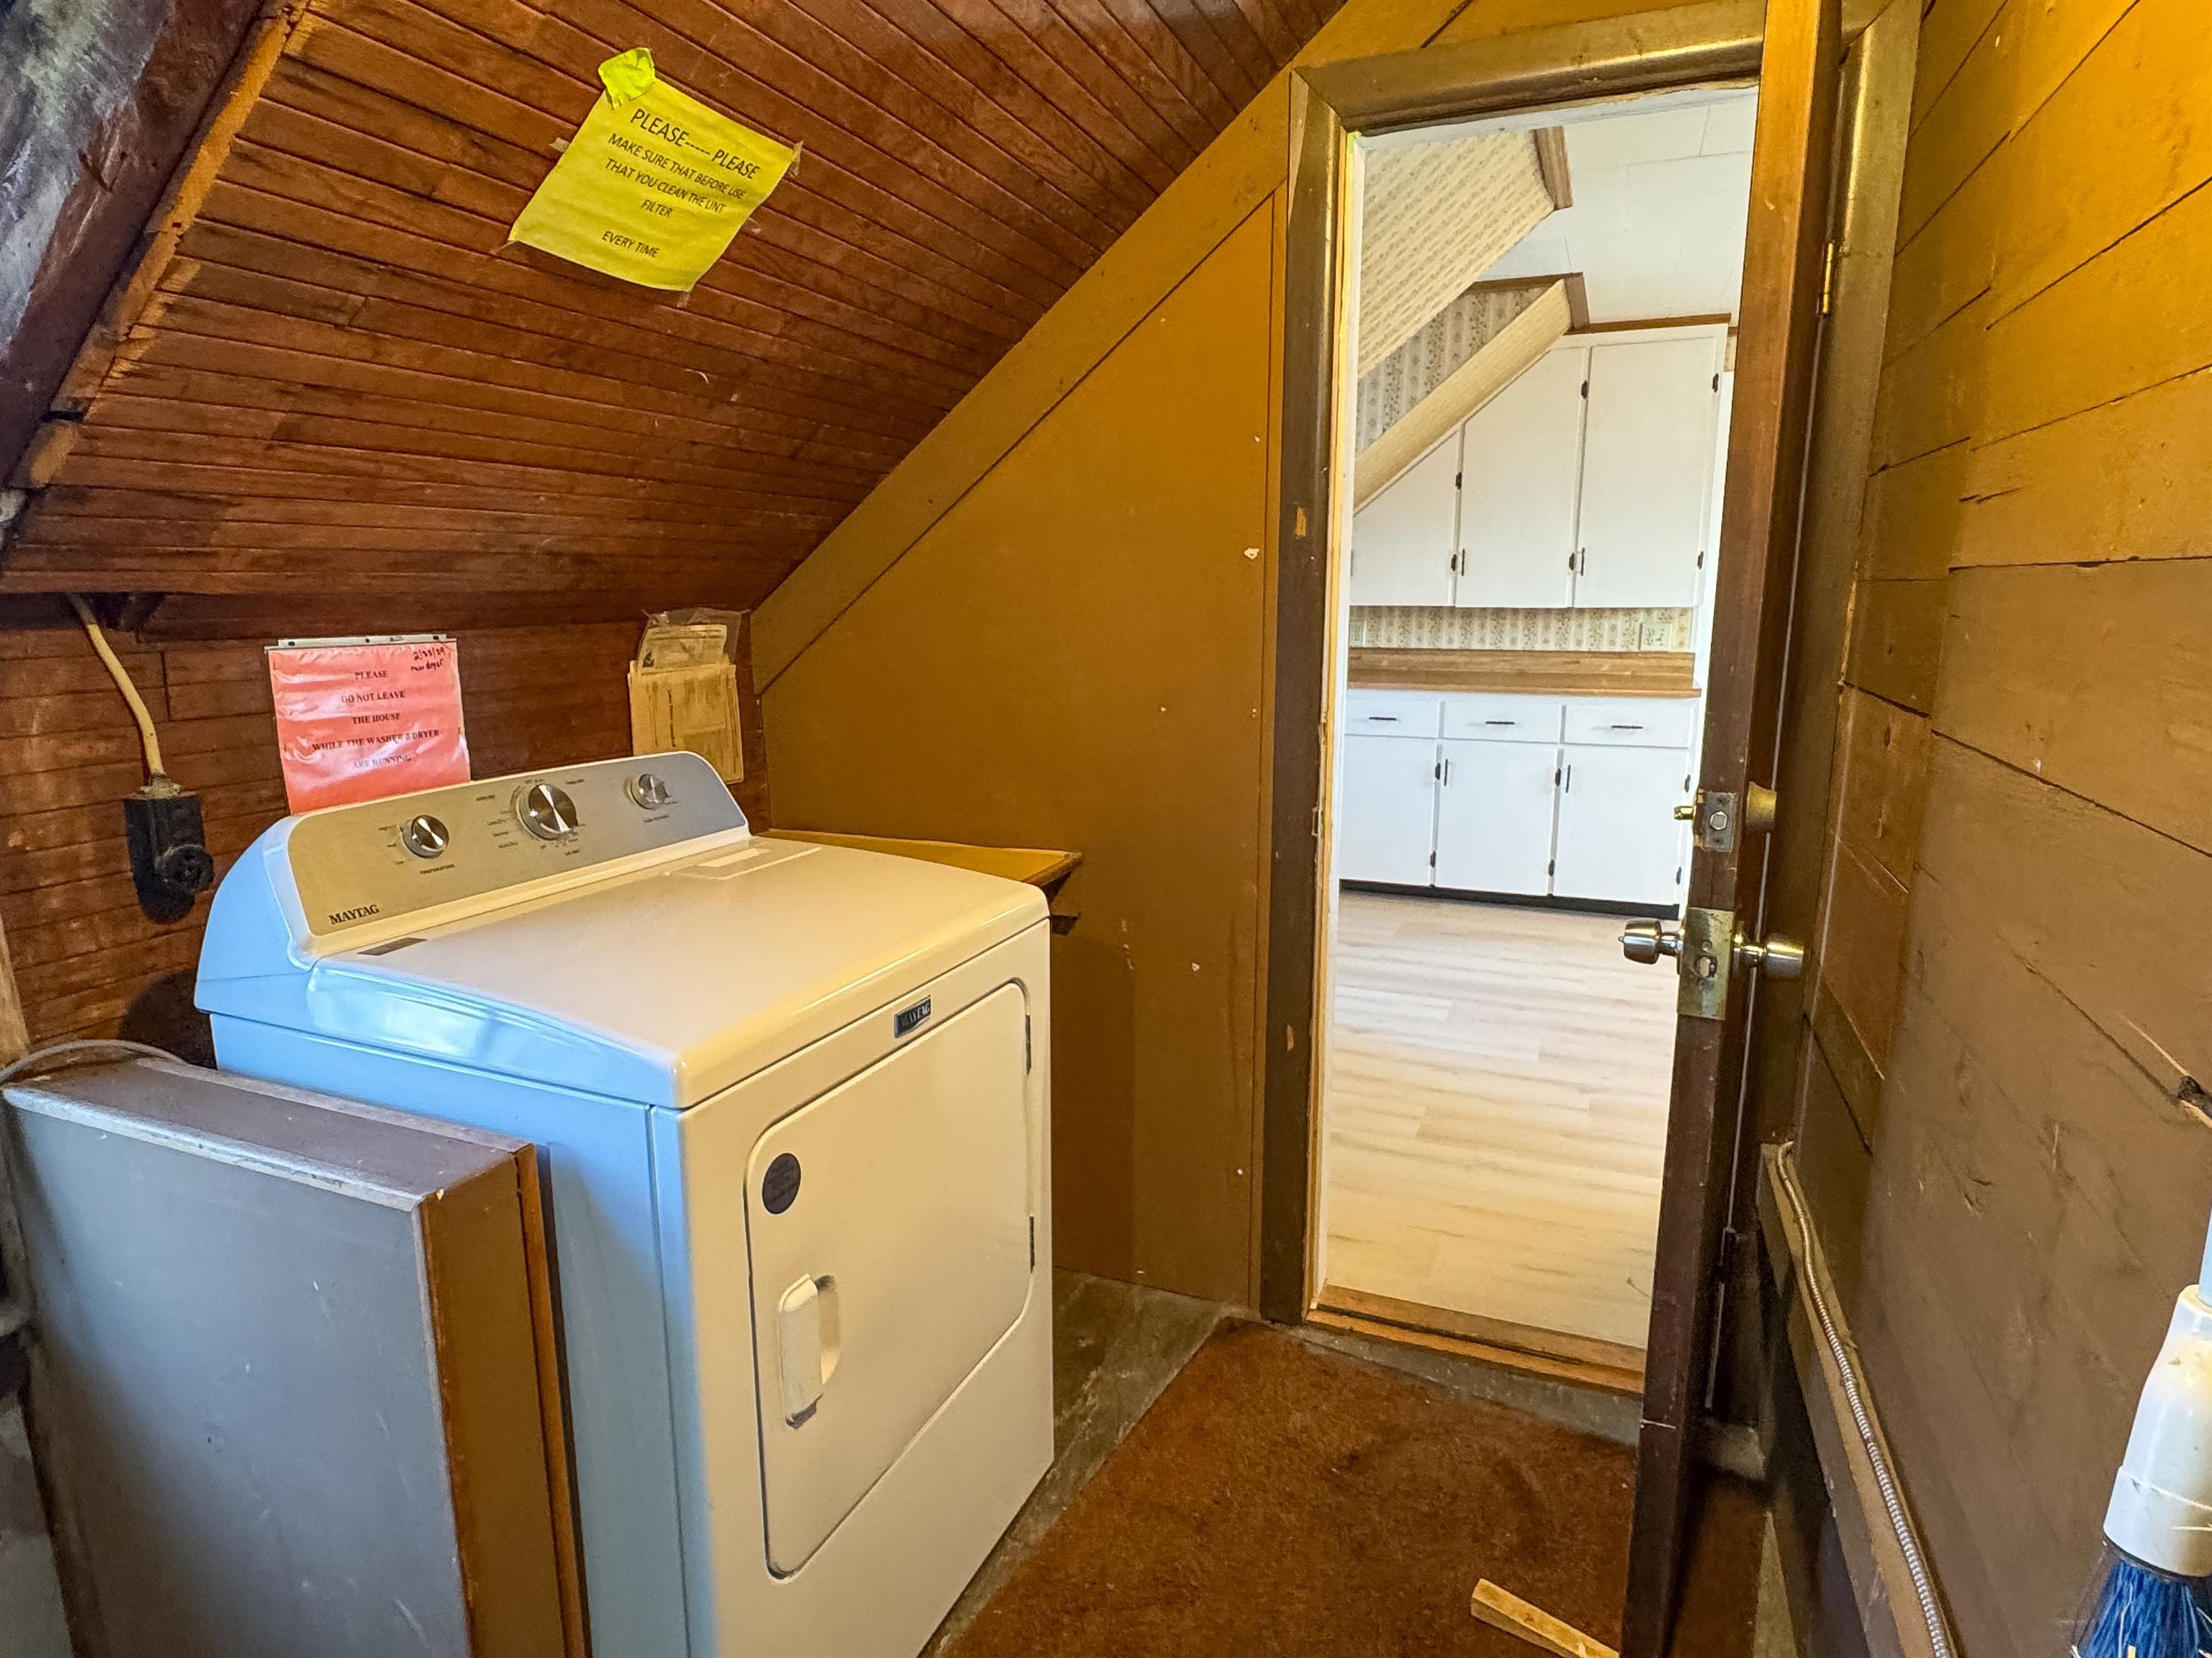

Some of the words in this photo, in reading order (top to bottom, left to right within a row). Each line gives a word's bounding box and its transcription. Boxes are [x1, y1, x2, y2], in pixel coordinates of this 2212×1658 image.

[608, 133, 643, 156] MAKE
[642, 149, 670, 169] SURE
[669, 161, 696, 180] THAT
[694, 173, 730, 194] BEFORE
[728, 186, 746, 199] USE
[711, 149, 760, 179] PLEASE
[605, 158, 636, 178] THAT
[635, 172, 657, 188] YOU
[657, 182, 688, 199] CLEAN
[687, 193, 708, 207] THE
[641, 199, 673, 217] FILTER
[601, 231, 635, 249] EVERY
[635, 240, 660, 258] TIME
[355, 670, 388, 680] PLEASE
[356, 693, 374, 702] NOT
[377, 690, 406, 700] LEAVE
[351, 716, 370, 724] THE
[372, 713, 401, 722] HOUSE
[312, 740, 343, 751] WHILE
[367, 734, 403, 744] WASHER
[412, 729, 439, 739] DRYER
[353, 759, 370, 769] ARE
[328, 904, 379, 925] MAYTAG
[899, 1001, 930, 1030] MAYTAG
